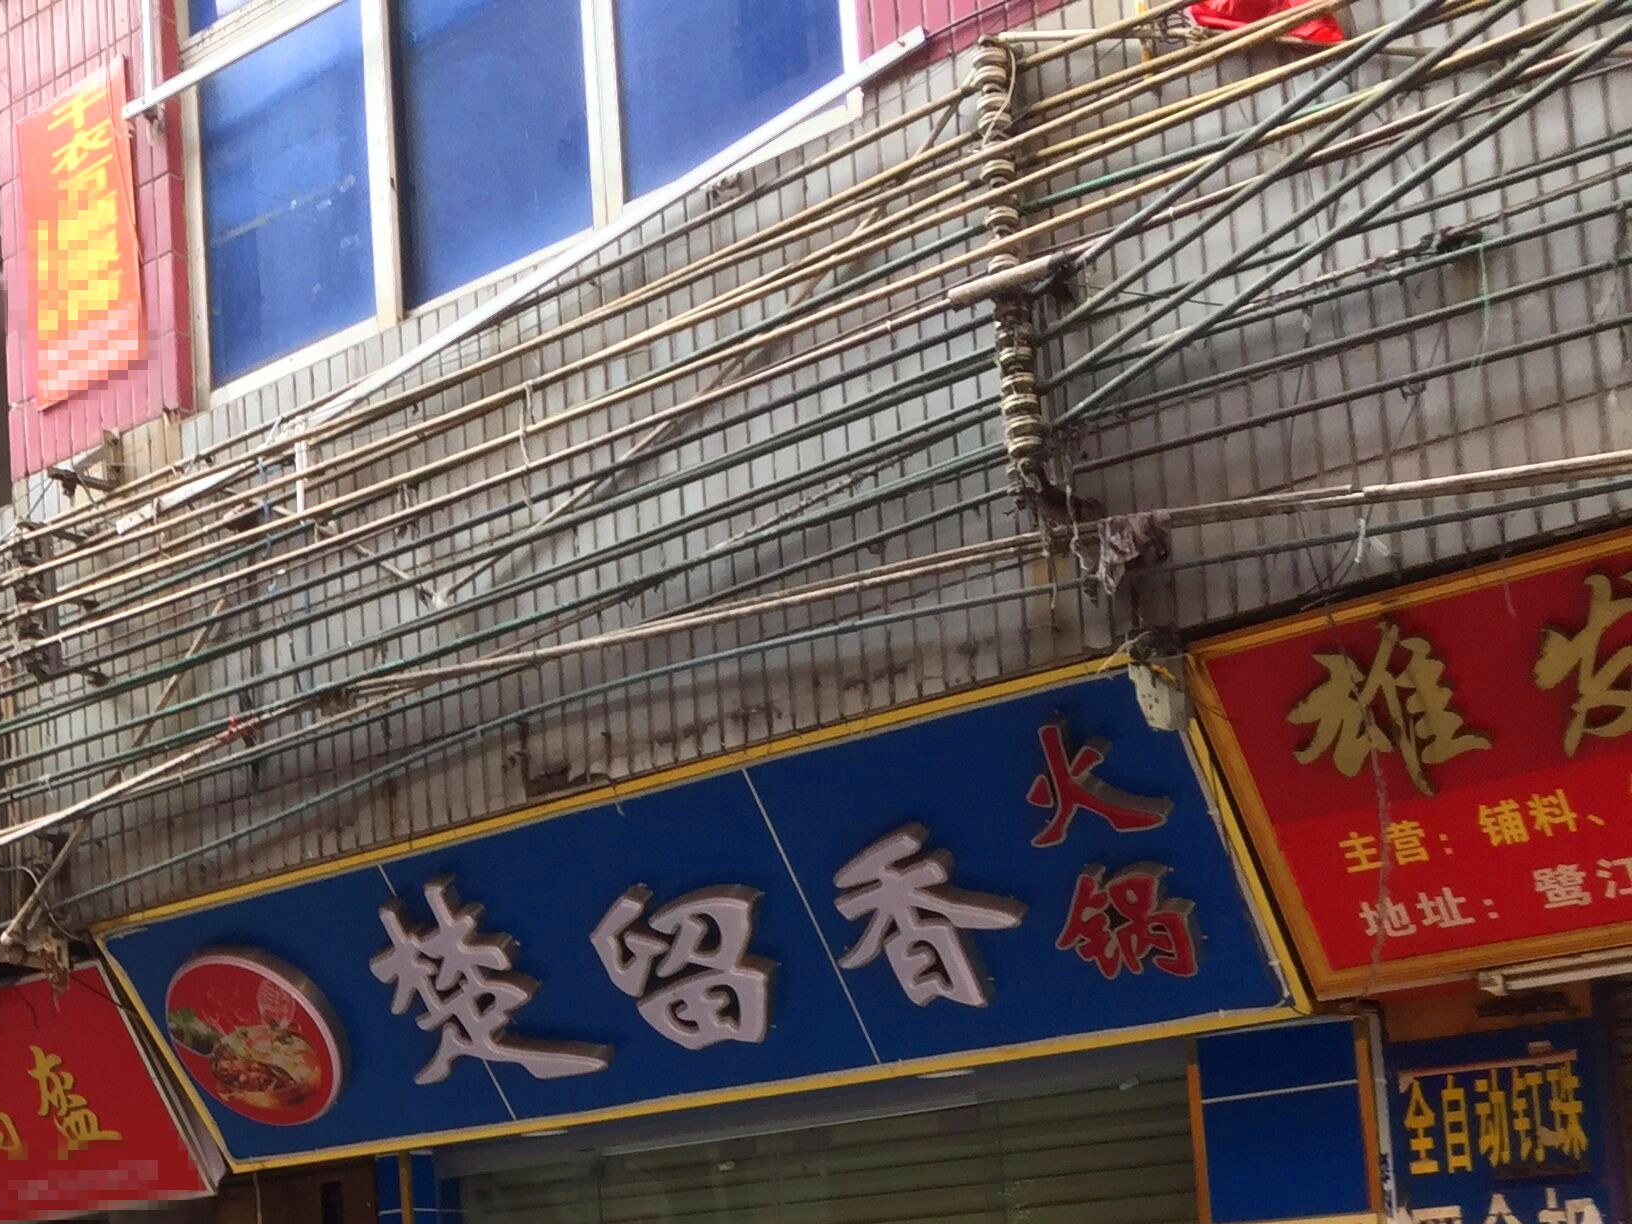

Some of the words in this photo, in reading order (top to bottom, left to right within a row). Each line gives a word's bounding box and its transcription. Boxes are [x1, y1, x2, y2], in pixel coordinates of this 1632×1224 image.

[370, 822, 1029, 1085] 楚留香
[1026, 717, 1200, 980] 火锅
[1404, 1062, 1589, 1176] 全自动钉珠
